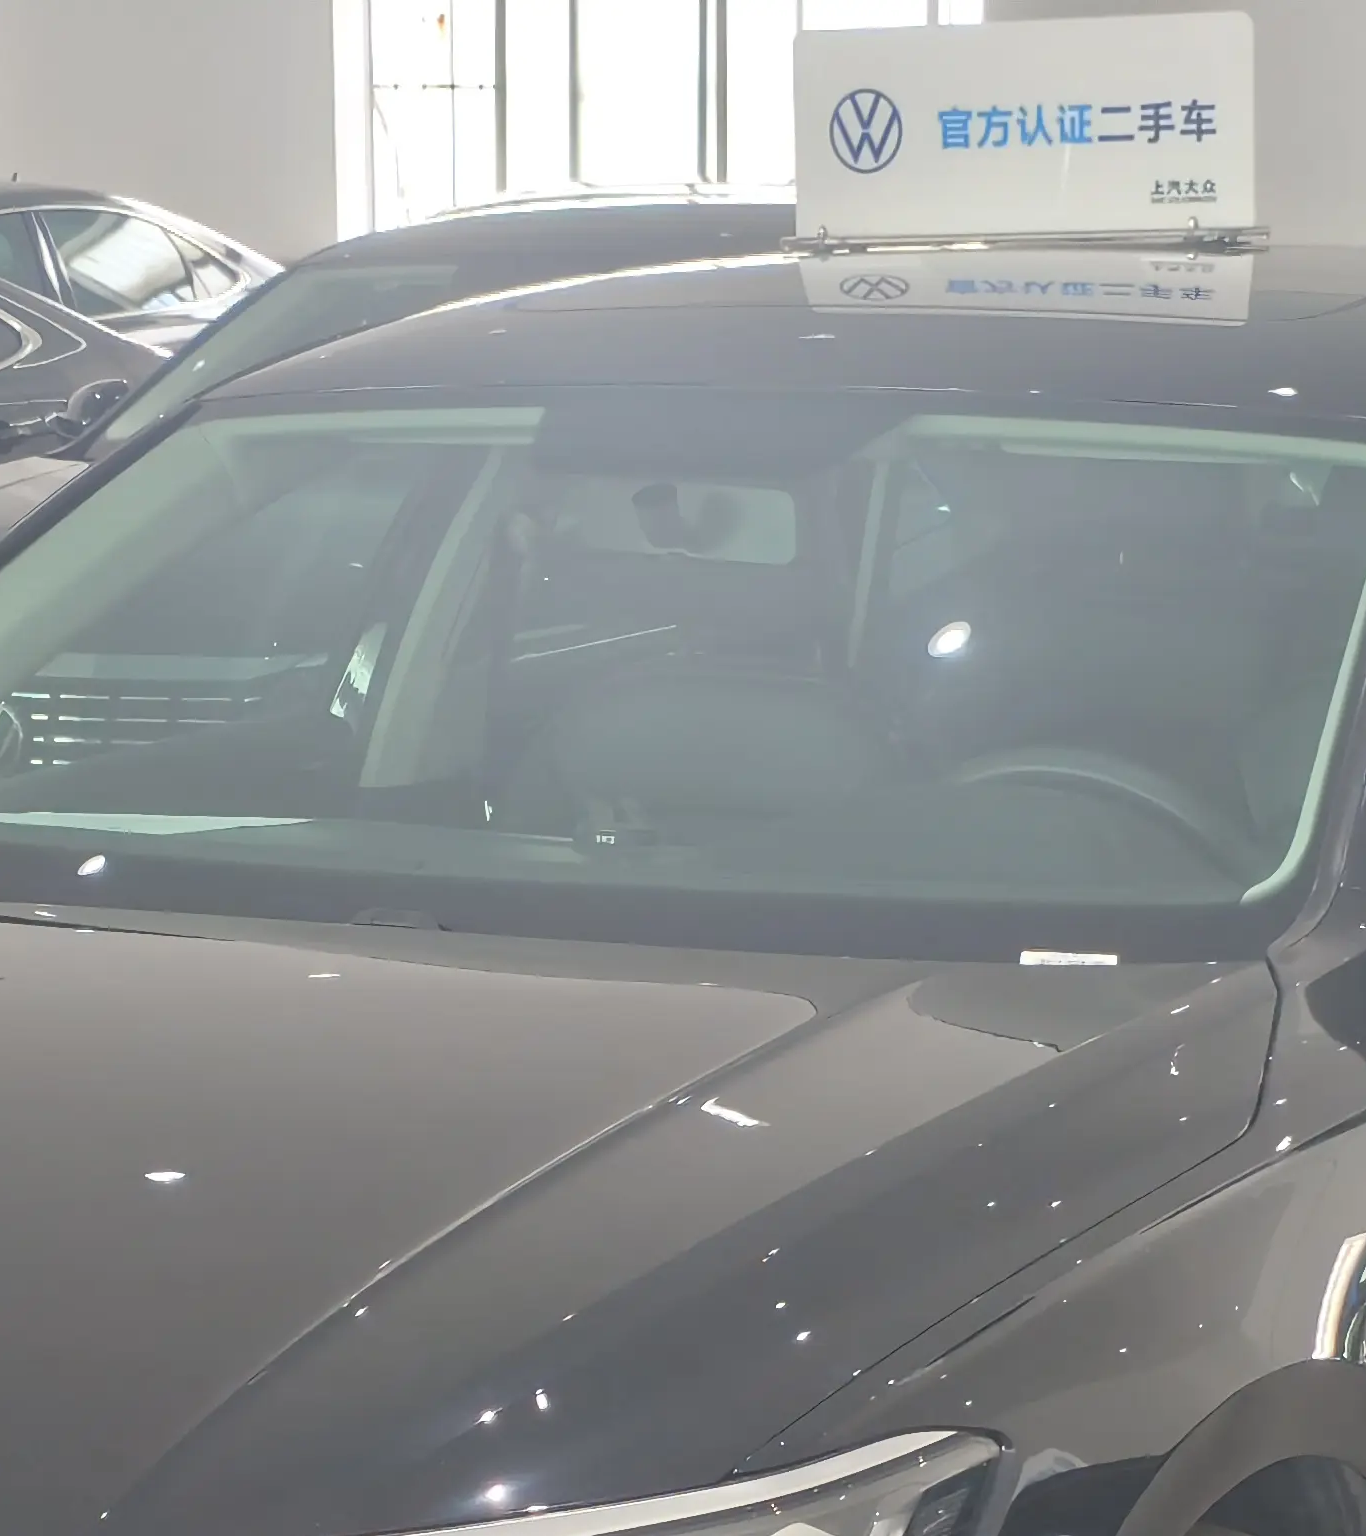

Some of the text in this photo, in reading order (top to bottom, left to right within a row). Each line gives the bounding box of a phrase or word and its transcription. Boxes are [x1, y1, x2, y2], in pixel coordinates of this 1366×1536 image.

[938, 99, 1217, 150] 官方认证二手车
[1150, 179, 1216, 196] 上汽大众
